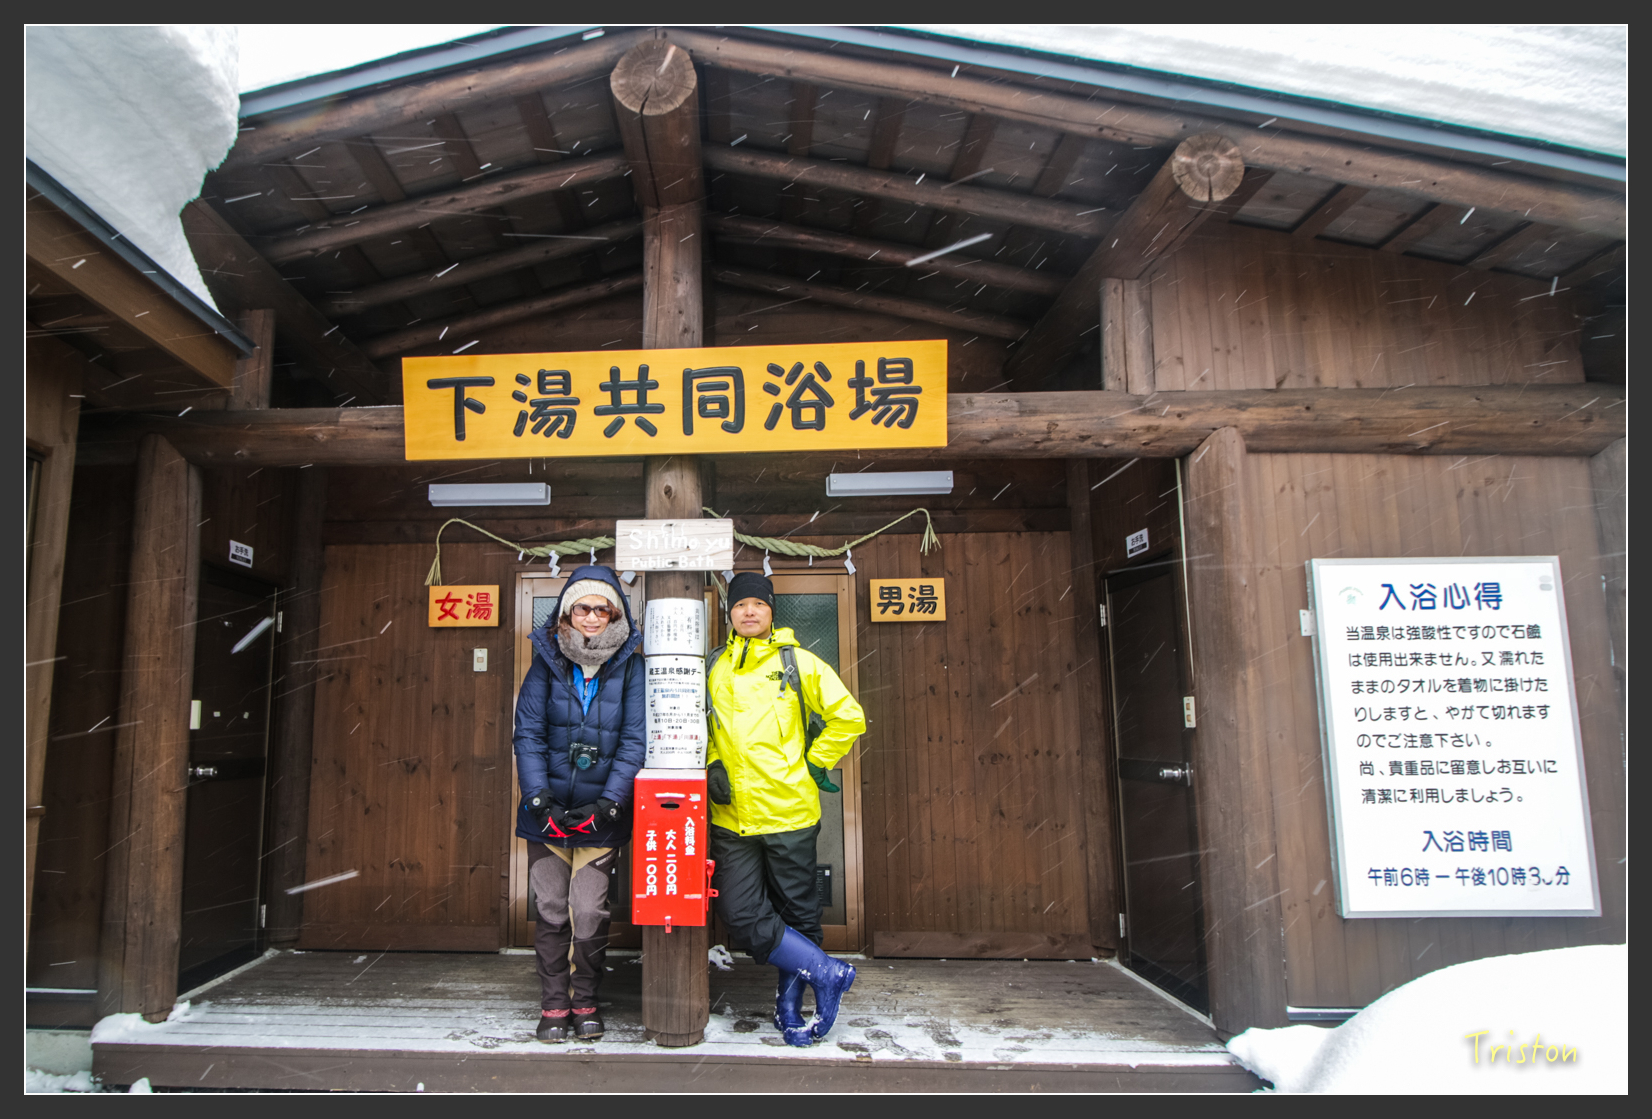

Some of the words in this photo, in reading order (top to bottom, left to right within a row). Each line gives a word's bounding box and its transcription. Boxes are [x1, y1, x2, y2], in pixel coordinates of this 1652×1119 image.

[427, 357, 922, 441] 下湯共同浴場
[631, 556, 674, 569] Public
[679, 555, 714, 568] Bath
[435, 591, 493, 621] 女湯
[877, 585, 938, 615] 男湯
[1379, 582, 1503, 611] 入浴心得
[1351, 677, 1548, 694] ままのタオルを着物に掛けた
[1354, 704, 1551, 722] りしますと、やがて切れます
[1356, 733, 1492, 749] のでご注意下さい。
[1359, 759, 1558, 776] 尚、貴重品に留意しお互いに
[1361, 788, 1523, 804] 清潔に利用しましょう。
[646, 830, 657, 851] 子供
[665, 829, 677, 851] 大人
[685, 817, 695, 855] 入浴料金
[1422, 831, 1512, 853] 入浴時間
